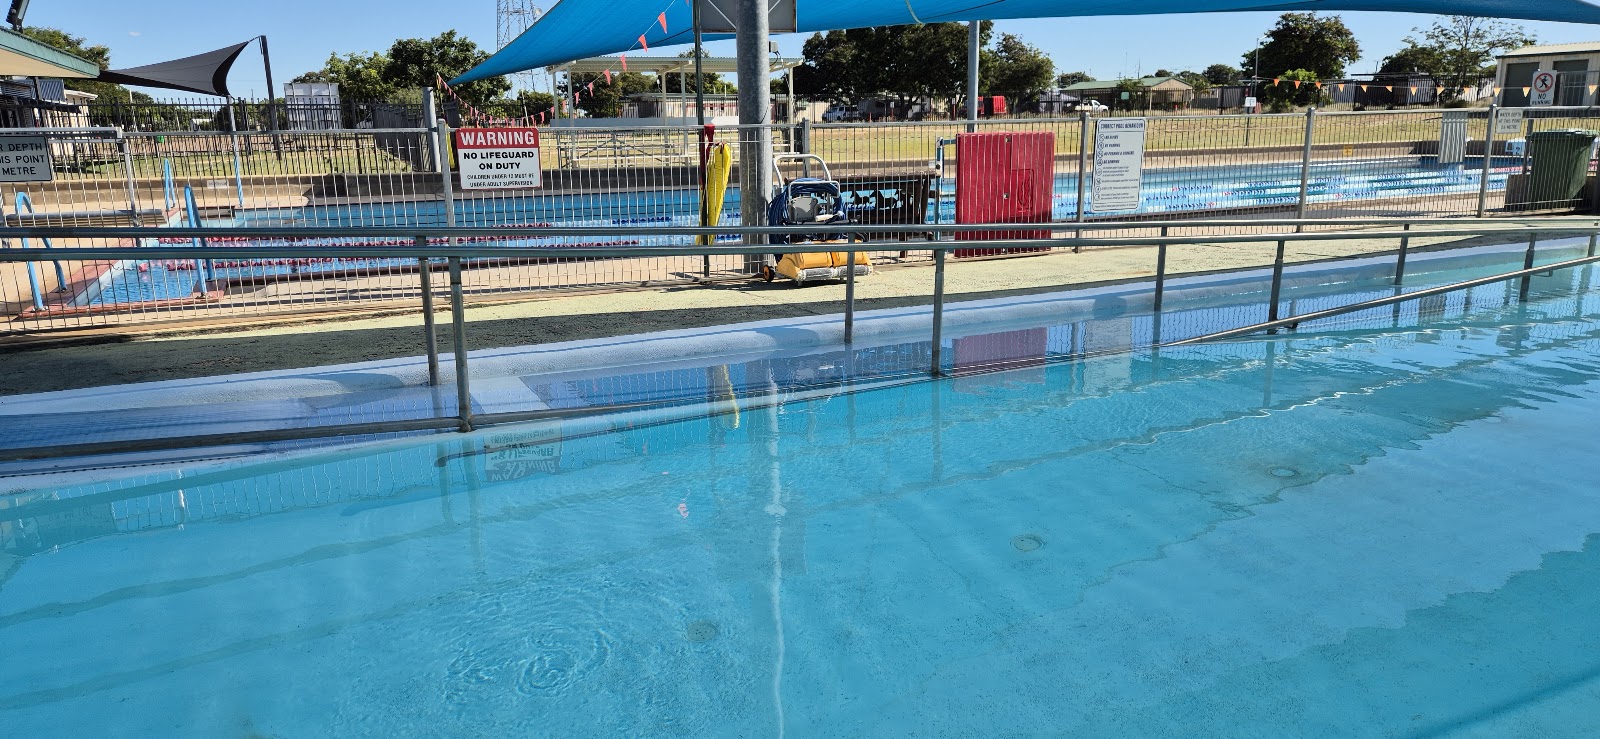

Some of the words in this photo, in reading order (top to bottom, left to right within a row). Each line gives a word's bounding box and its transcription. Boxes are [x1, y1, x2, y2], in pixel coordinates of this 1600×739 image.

[460, 132, 534, 146] WARNING
[8, 143, 42, 151] DEPTH
[16, 155, 44, 163] POINT
[2, 167, 36, 175] METRE
